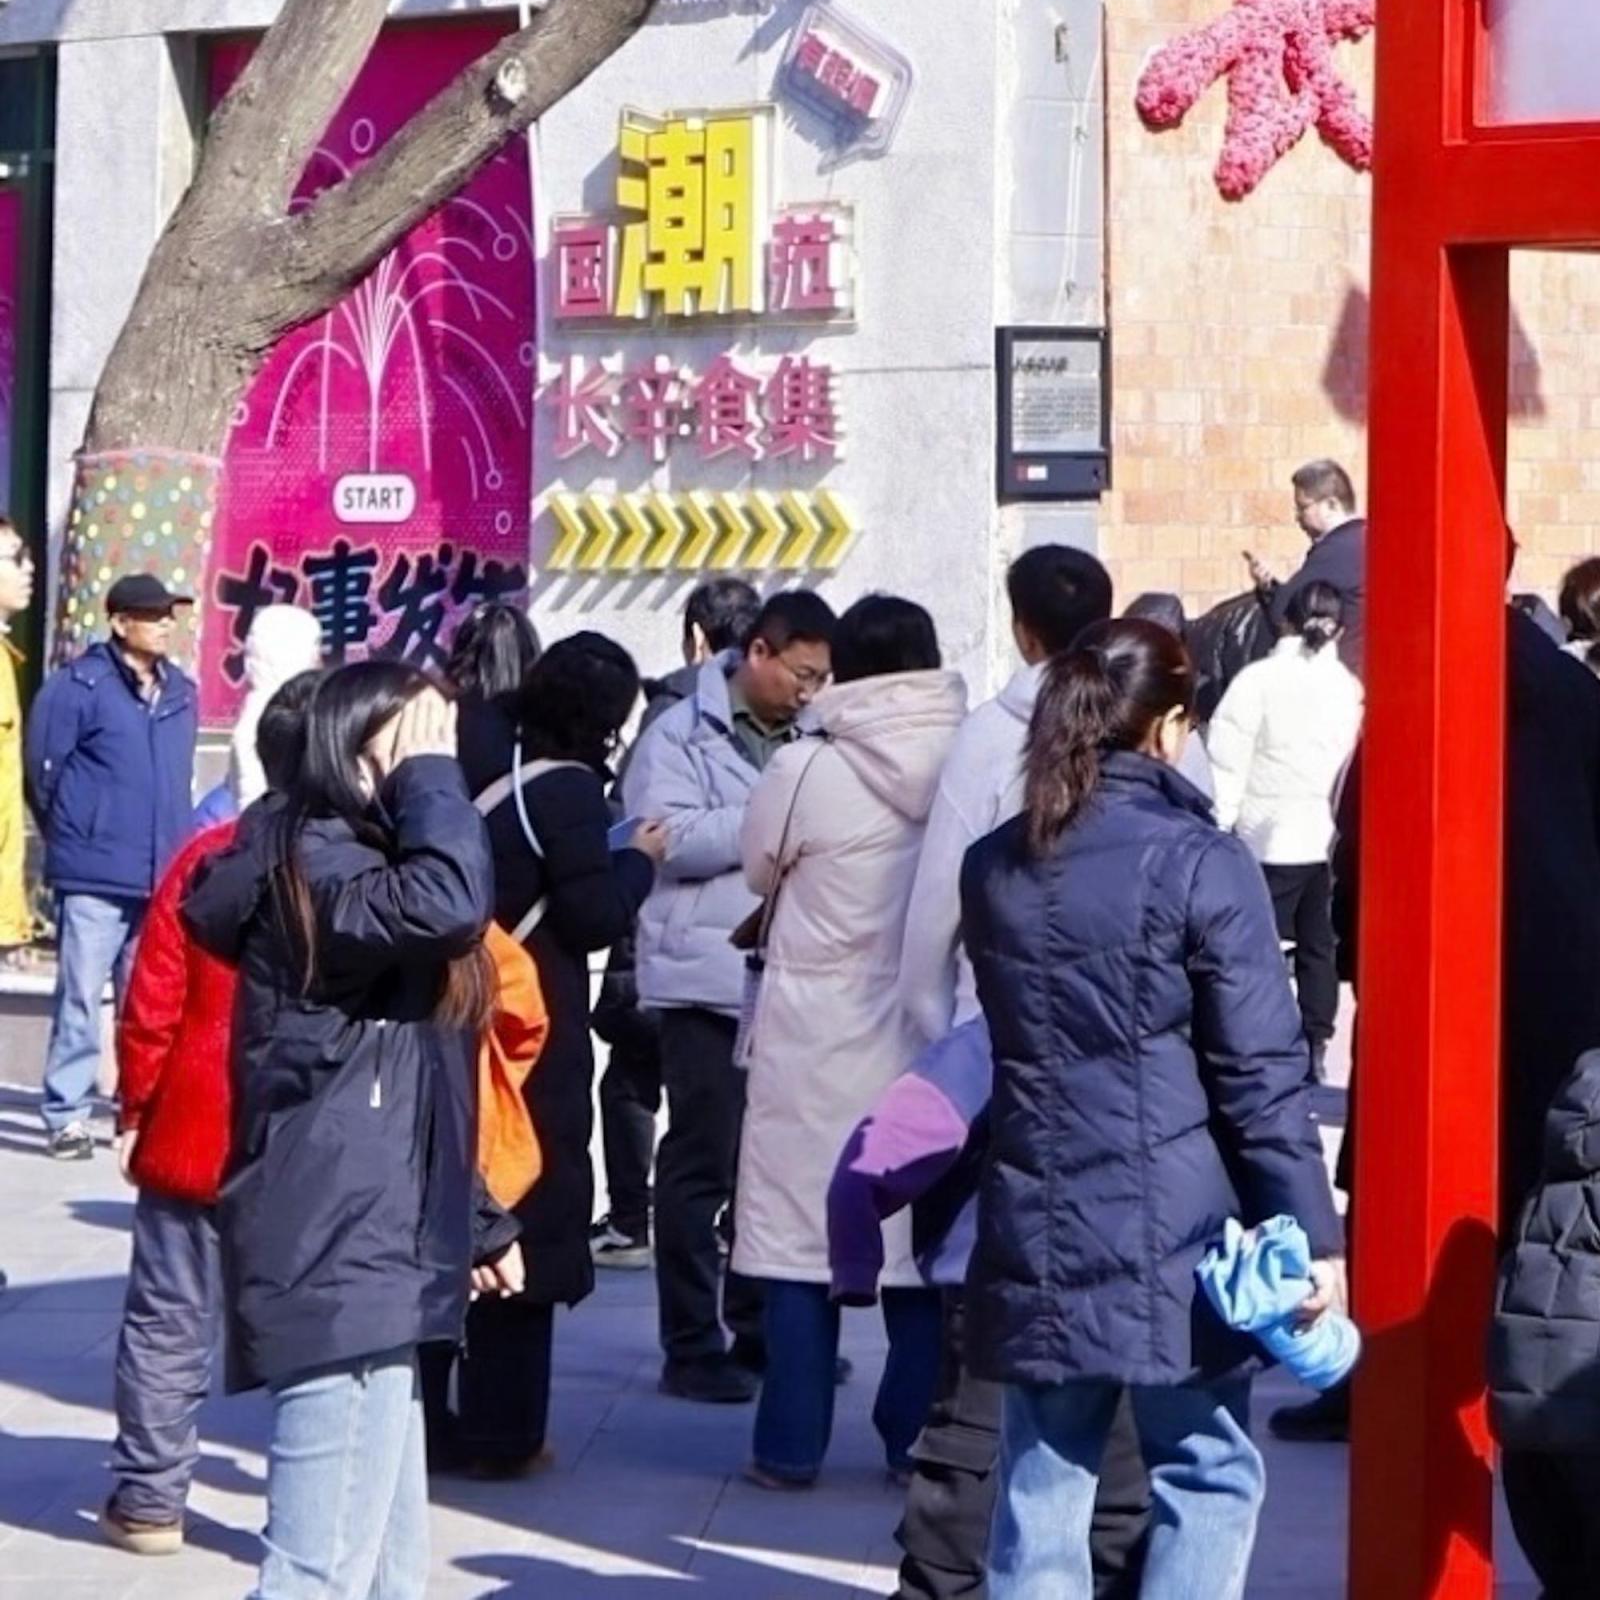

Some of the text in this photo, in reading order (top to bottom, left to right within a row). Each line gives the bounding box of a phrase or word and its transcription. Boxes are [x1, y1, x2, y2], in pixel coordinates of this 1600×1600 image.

[550, 353, 840, 462] 长辛食集
[342, 486, 405, 511] START
